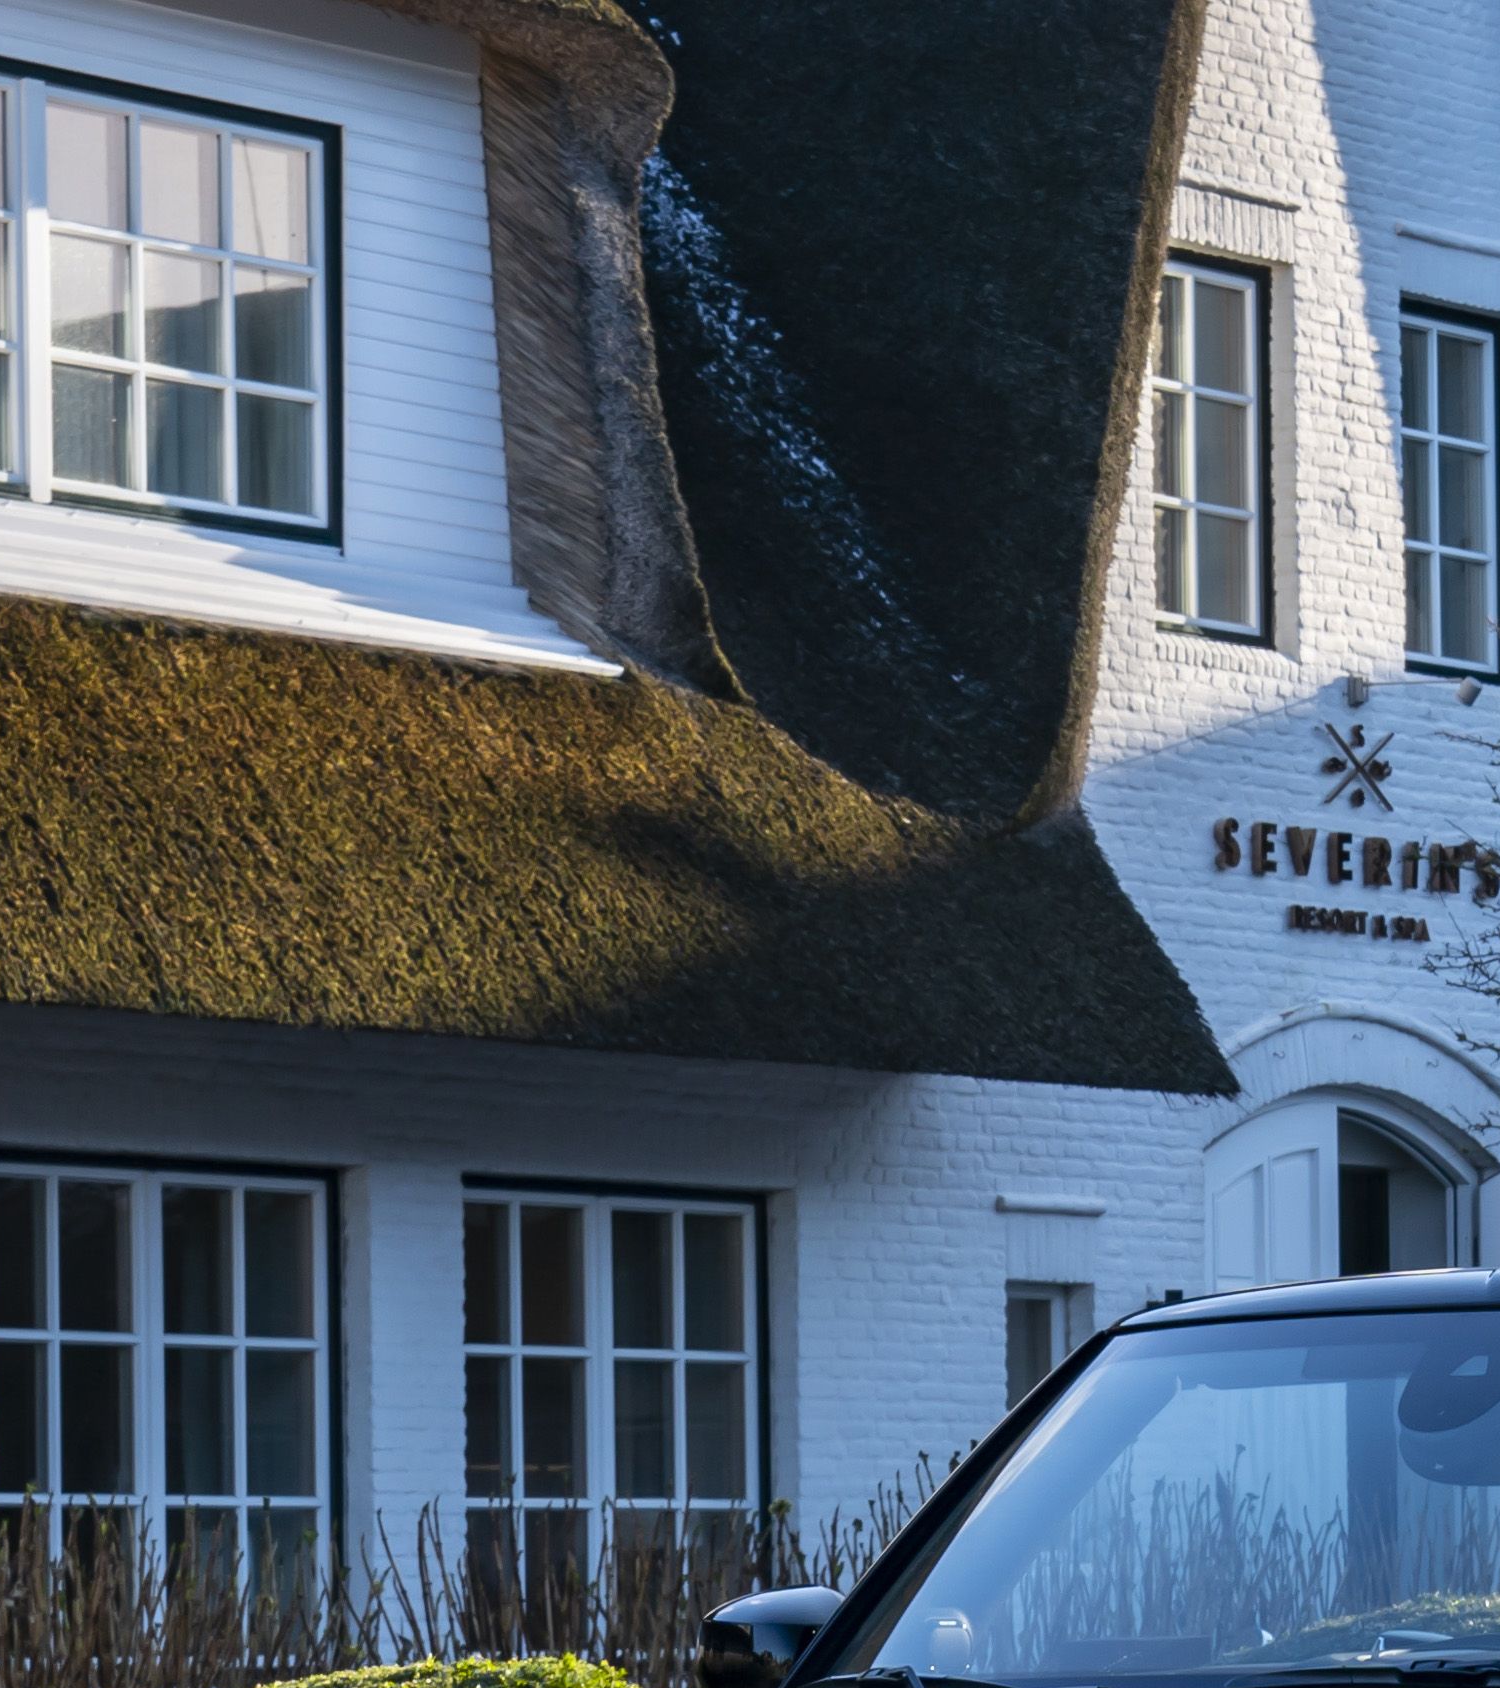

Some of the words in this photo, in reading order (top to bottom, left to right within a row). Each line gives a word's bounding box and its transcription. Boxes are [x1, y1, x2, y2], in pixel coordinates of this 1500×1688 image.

[1289, 904, 1368, 933] RESORT
[1373, 914, 1388, 940] &
[1391, 916, 1431, 942] SPA
